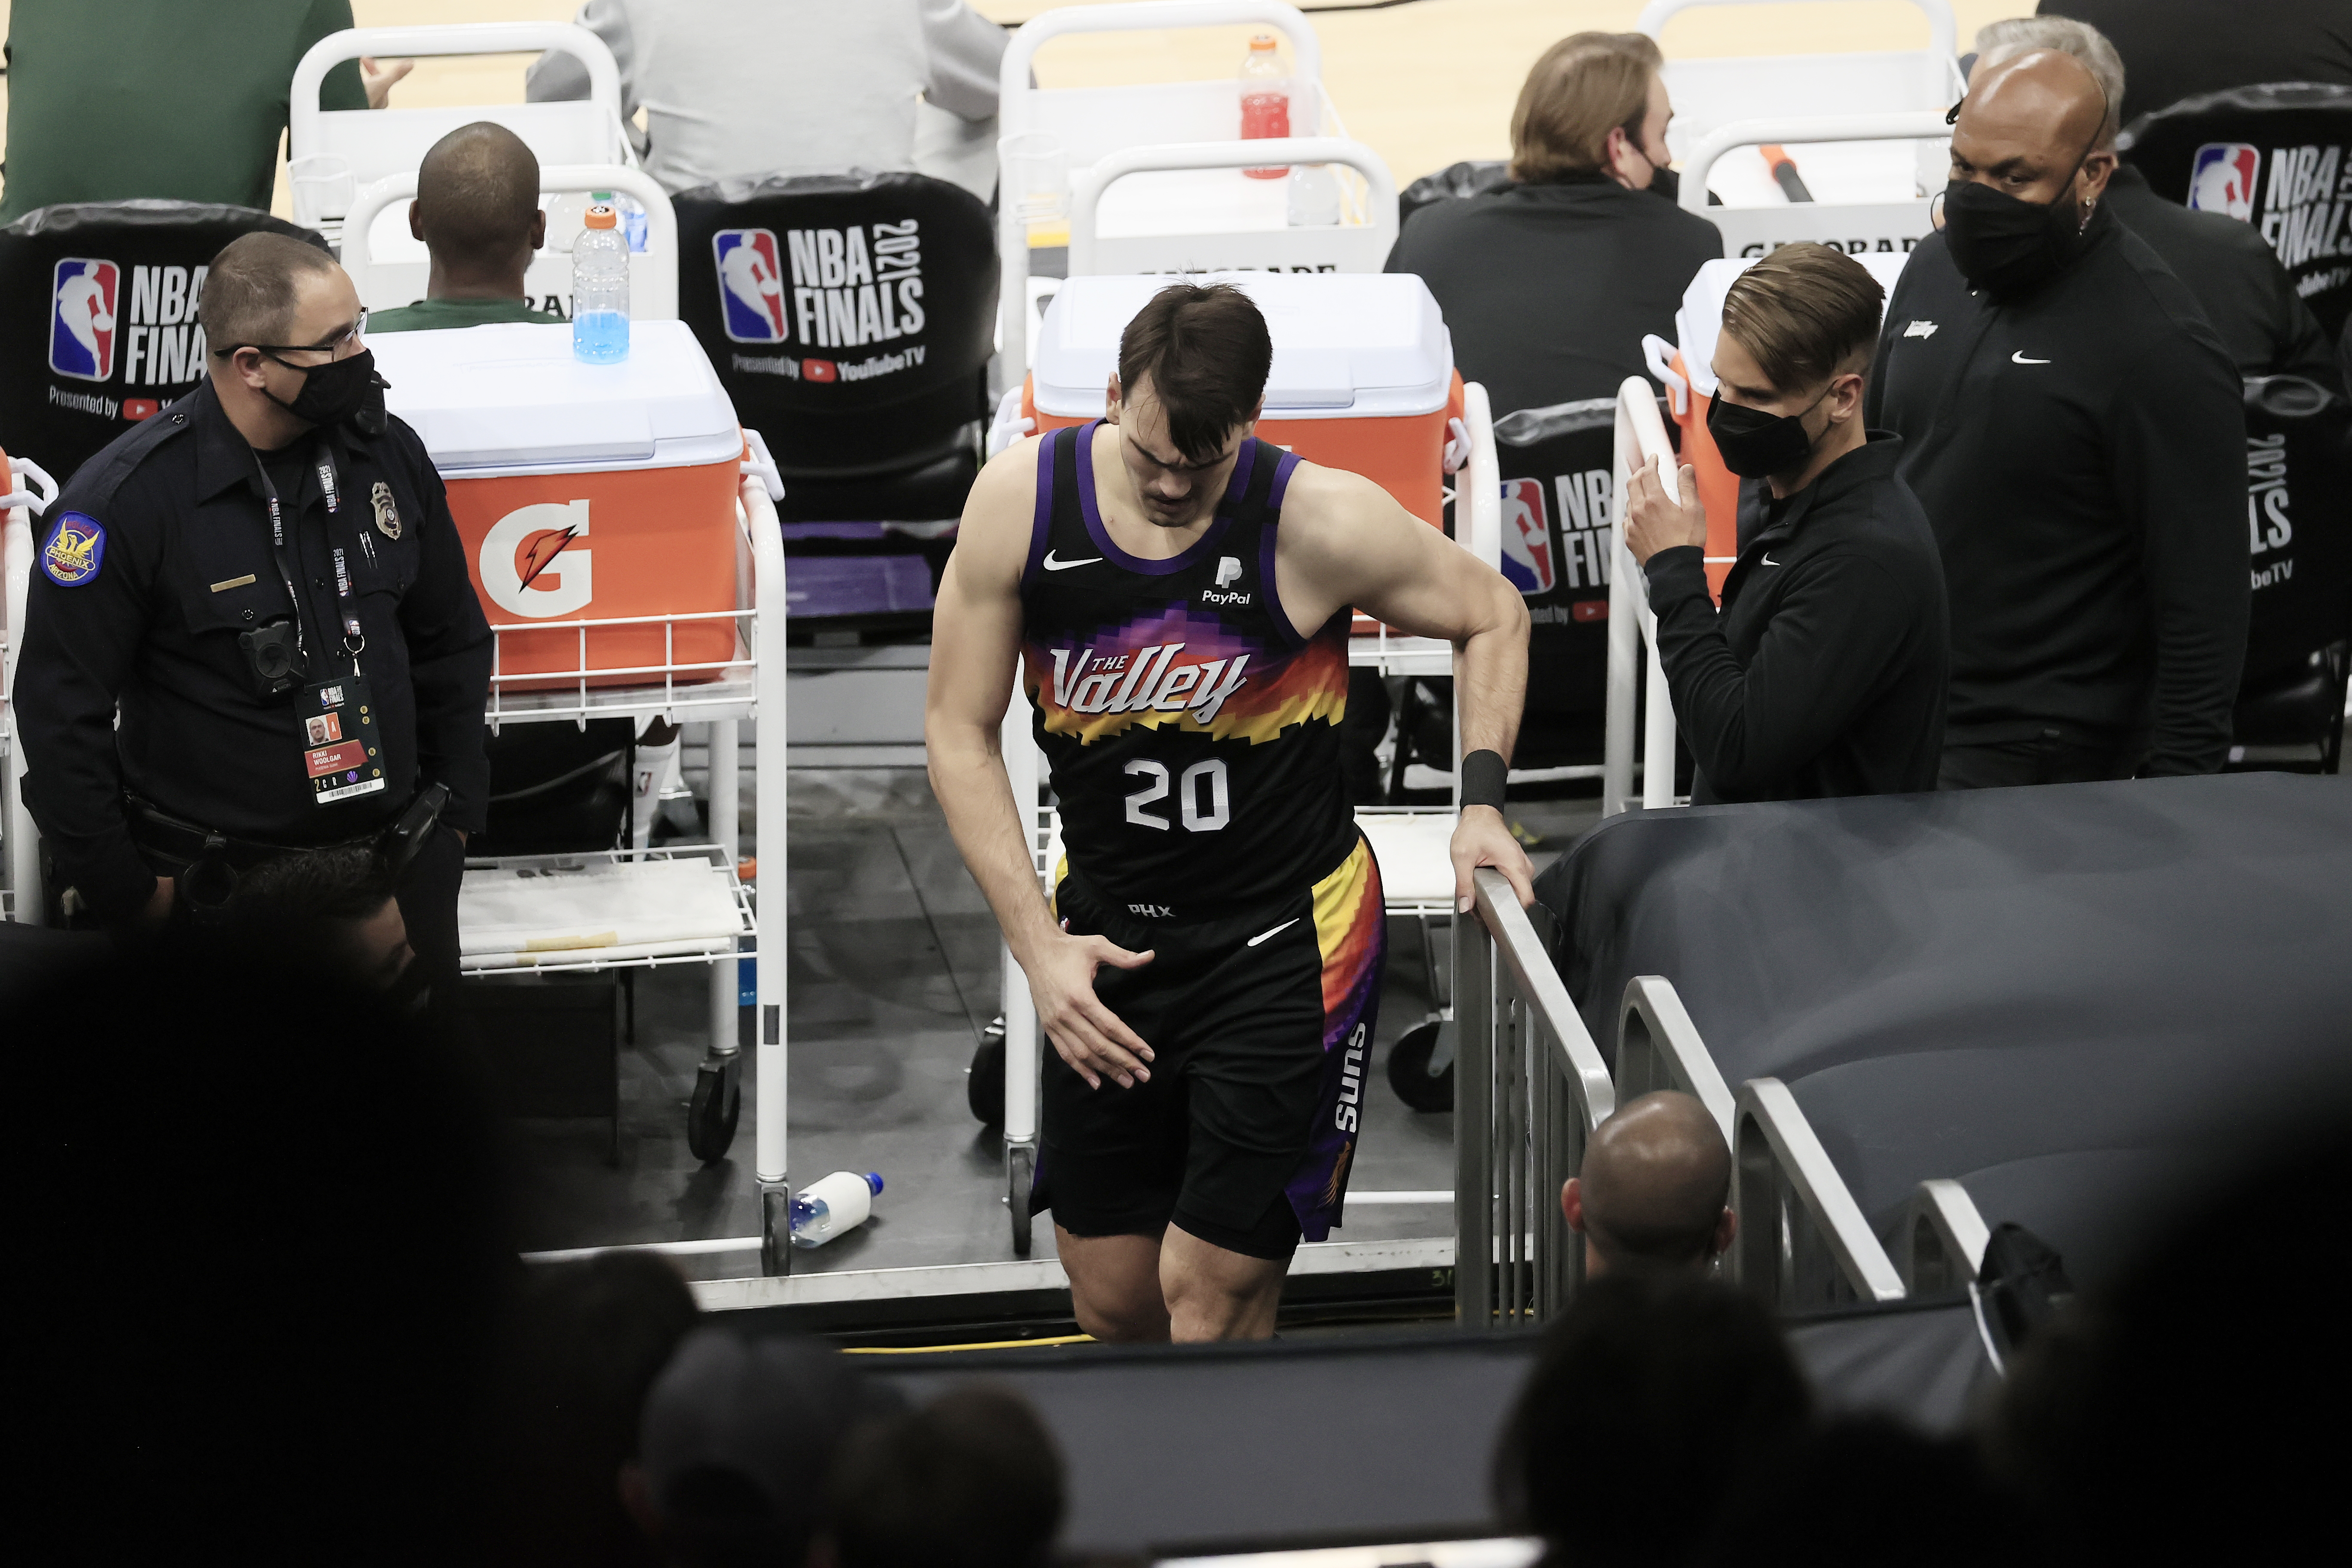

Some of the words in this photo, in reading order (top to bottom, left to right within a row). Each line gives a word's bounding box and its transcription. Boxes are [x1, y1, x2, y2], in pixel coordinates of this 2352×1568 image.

[2264, 144, 2341, 211] NBA
[787, 225, 873, 288] NBA
[873, 218, 922, 283] 2021
[794, 277, 925, 347] FINALS
[125, 324, 208, 385] FINA
[49, 385, 104, 415] Presented
[104, 397, 118, 420] by
[319, 465, 331, 475] 2021
[321, 472, 335, 494] FINALS
[271, 503, 280, 516] NBA
[326, 494, 337, 508] NBA
[1554, 469, 1613, 531] NB
[273, 517, 282, 537] FINALS
[49, 548, 89, 568] PHOENIX
[334, 548, 344, 557] 2021
[479, 499, 592, 618] G
[49, 564, 79, 579] ARIZONA
[334, 556, 346, 578] FINALS
[337, 577, 349, 591] NBA
[1202, 590, 1251, 605] PayPal
[1092, 655, 1130, 671] THE
[1049, 642, 1251, 724] Valley
[331, 721, 337, 732] A
[312, 750, 327, 759] RIKKI
[313, 753, 342, 766] WOOLGAR
[314, 779, 321, 792] 2
[332, 777, 337, 786] R
[1123, 756, 1231, 833] 20
[1127, 904, 1176, 917] PHX
